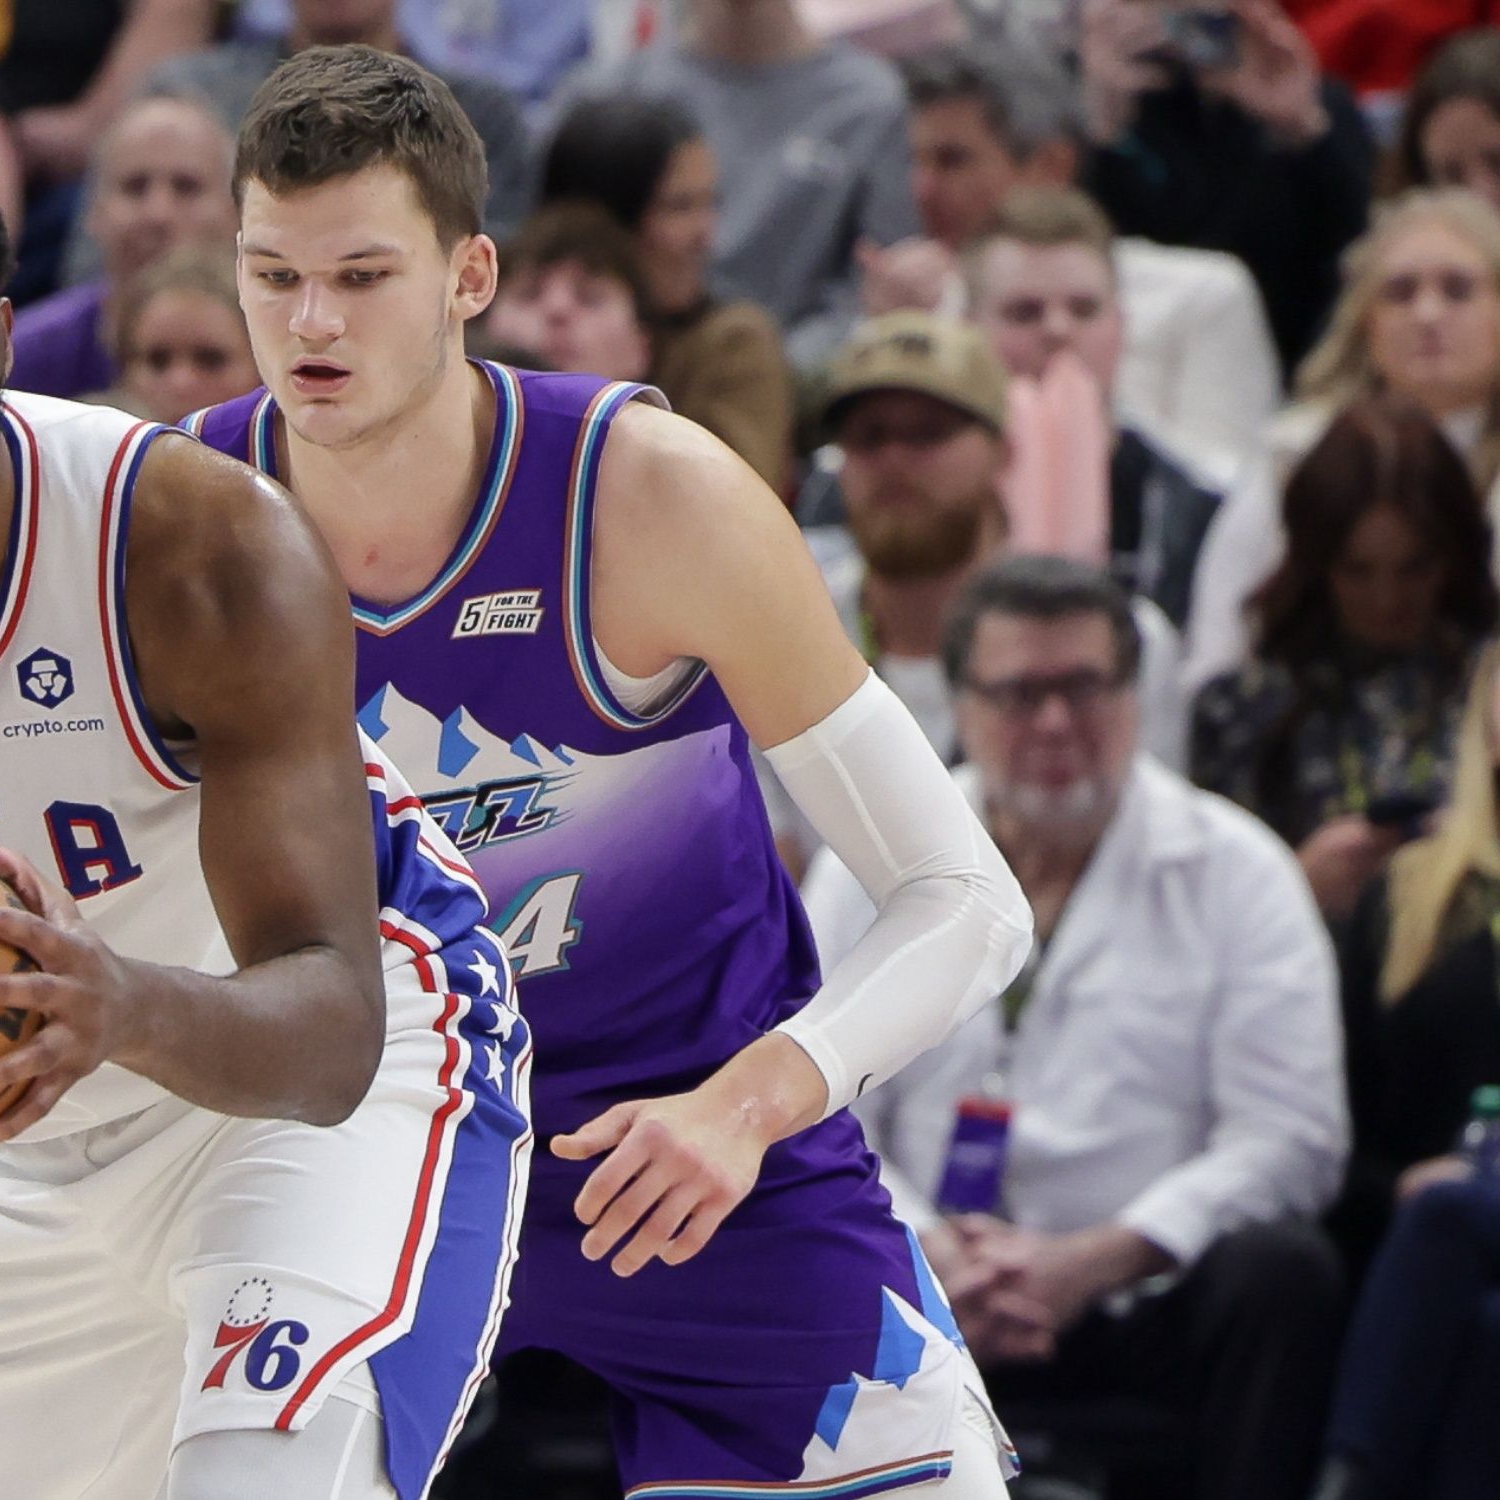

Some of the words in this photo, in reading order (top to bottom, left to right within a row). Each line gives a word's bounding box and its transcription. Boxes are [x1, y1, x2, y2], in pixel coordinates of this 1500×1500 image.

[460, 601, 485, 632] 5
[494, 596, 515, 607] FOR
[516, 595, 534, 606] THE
[487, 613, 537, 630] FIGHT
[3, 718, 105, 738] crypto.com
[419, 777, 555, 853] ZZ
[493, 869, 584, 981] 4
[201, 1316, 310, 1392] 76
